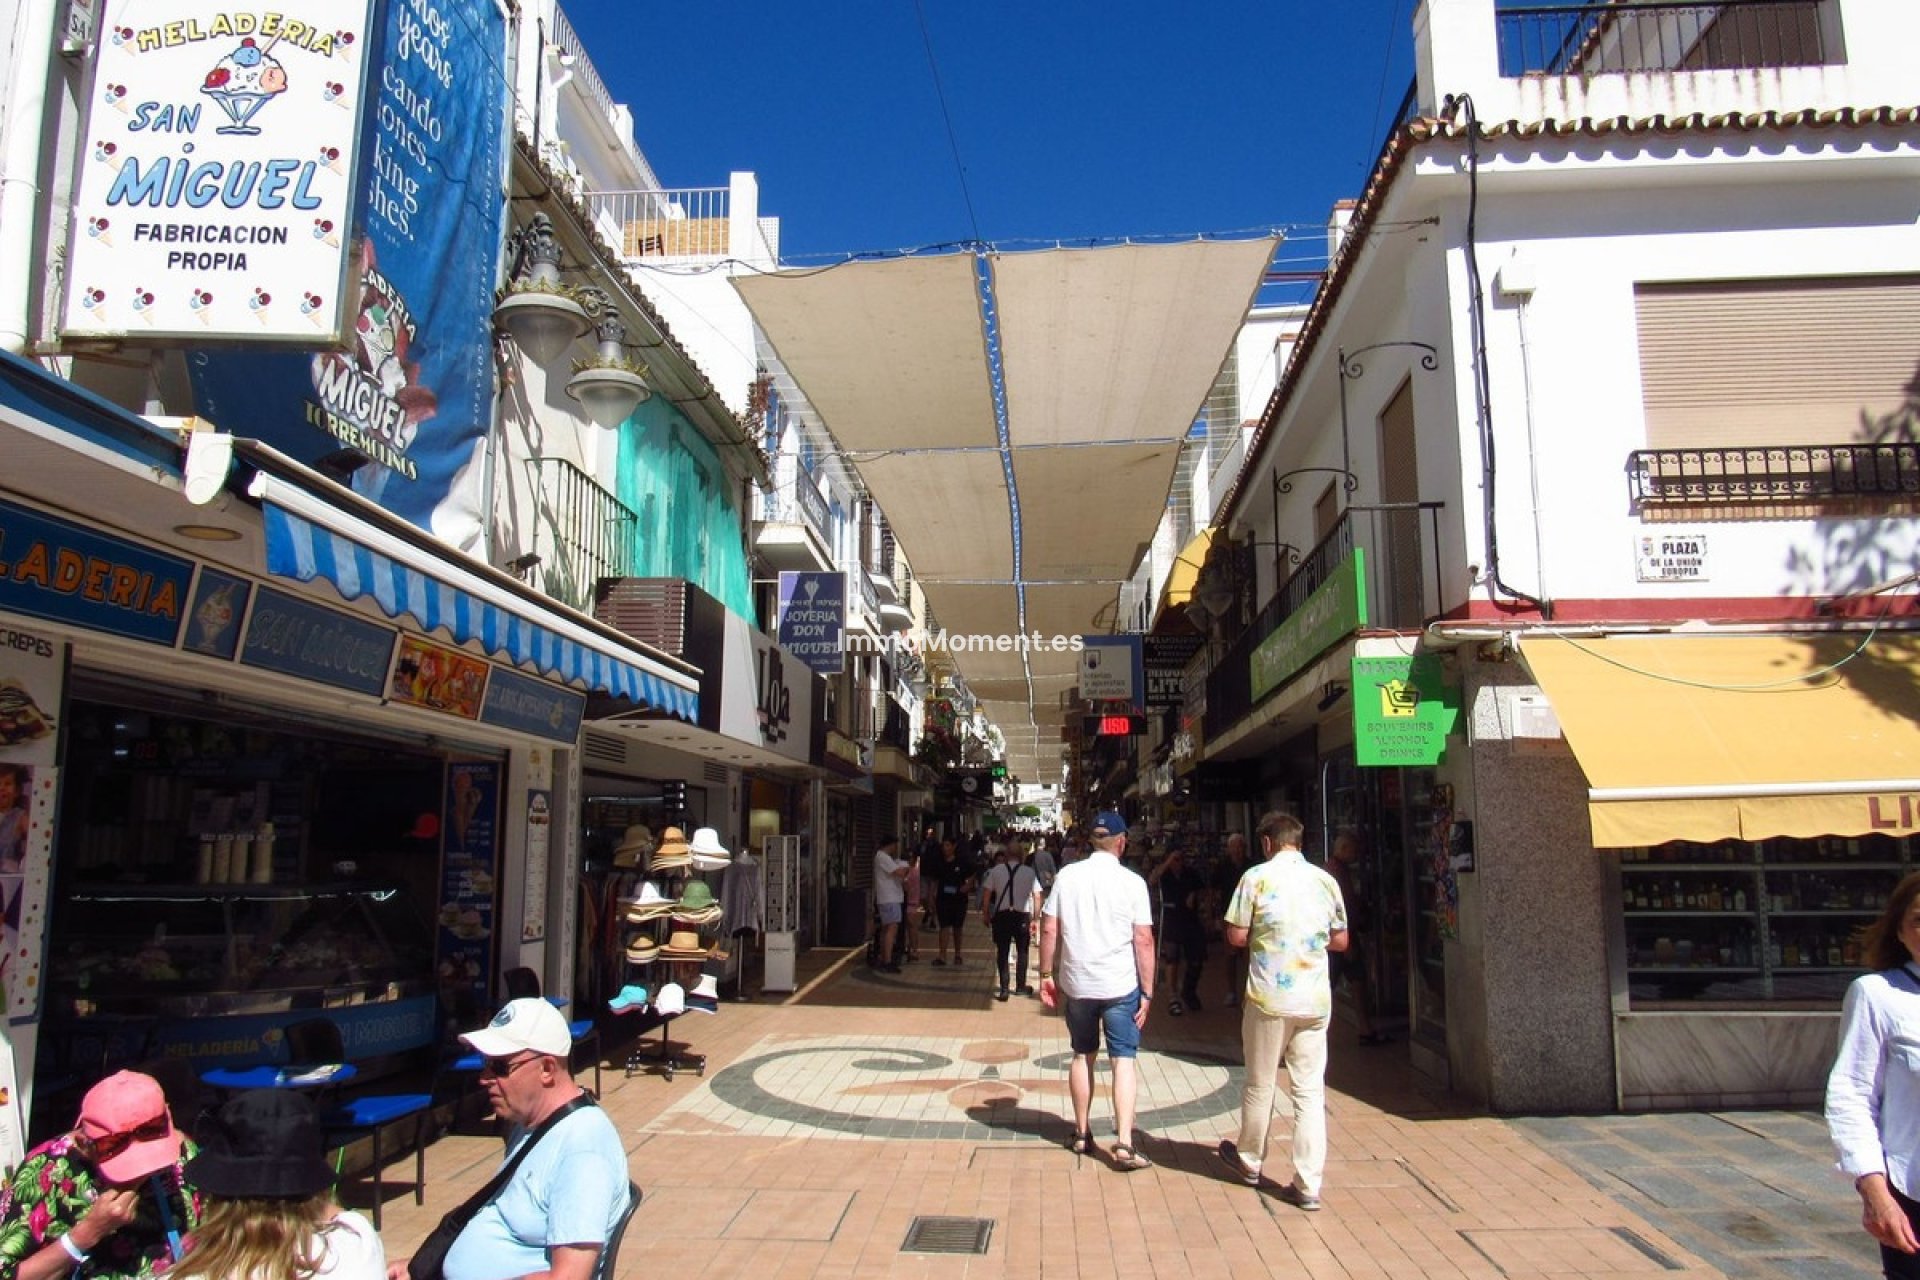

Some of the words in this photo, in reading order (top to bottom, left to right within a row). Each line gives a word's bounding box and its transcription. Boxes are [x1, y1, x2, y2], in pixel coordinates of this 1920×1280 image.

[137, 12, 336, 58] HELADERIA
[128, 101, 201, 134] SAN
[106, 142, 322, 210] MIGUEL
[133, 223, 288, 245] FABRICACION
[167, 251, 247, 271] PROPIA
[319, 359, 406, 448] MIGUEL
[1662, 542, 1699, 554] PLAZA
[1650, 558, 1660, 567] DE
[785, 610, 838, 623] JOYERIA
[792, 624, 826, 638] DON
[1367, 722, 1435, 733] SOUVENIRS
[1380, 748, 1425, 759] DRINKS
[1868, 794, 1920, 829] LI
